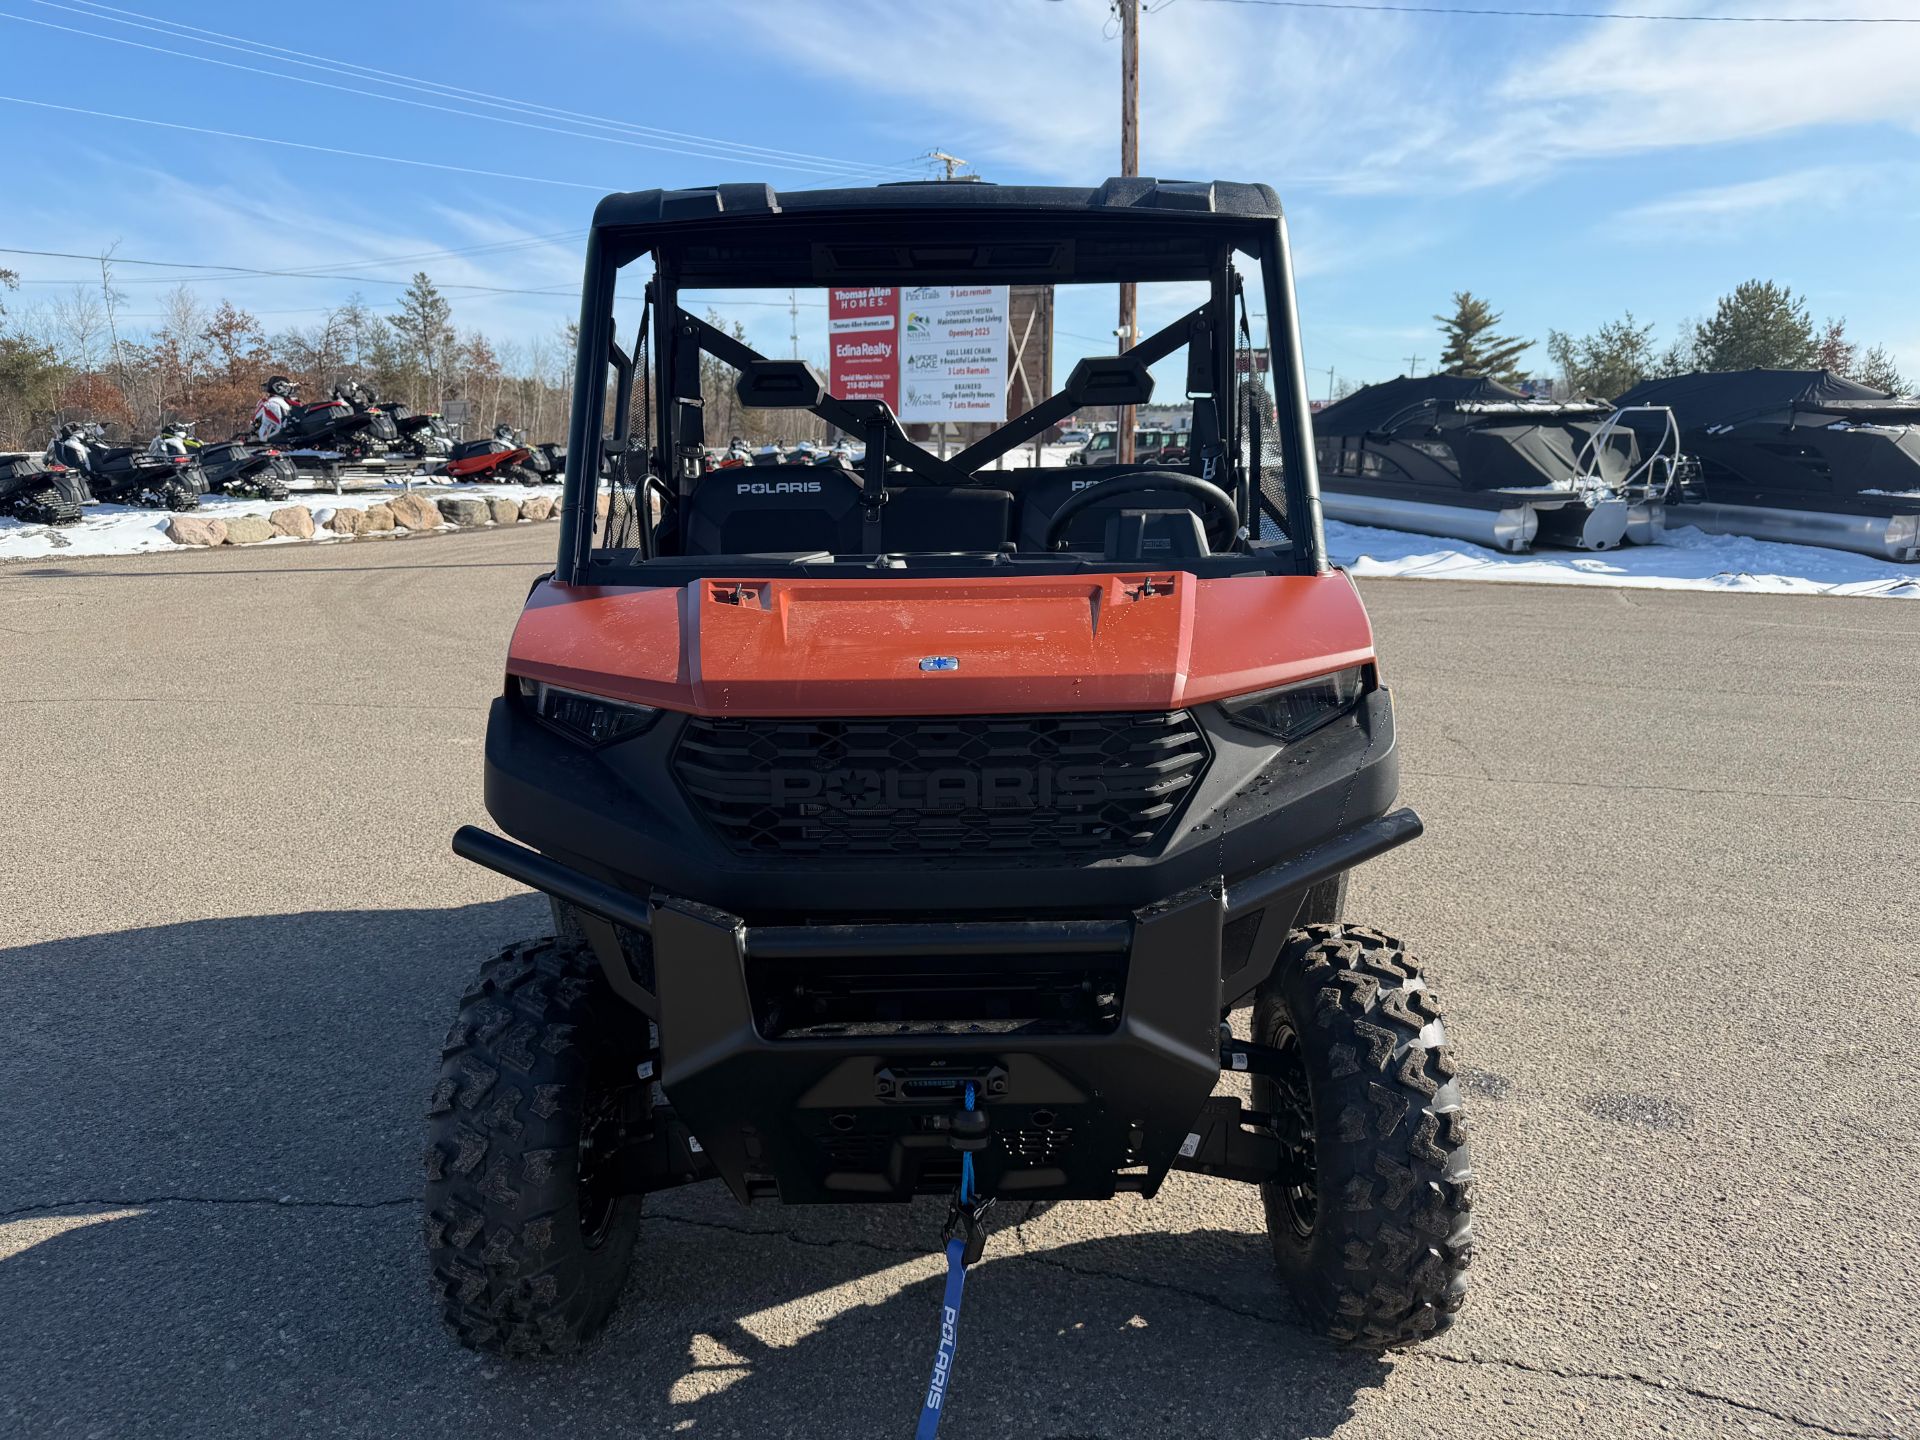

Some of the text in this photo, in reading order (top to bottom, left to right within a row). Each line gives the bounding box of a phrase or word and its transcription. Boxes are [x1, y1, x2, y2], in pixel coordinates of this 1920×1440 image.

[835, 287, 891, 301] Thomas Allen
[921, 289, 940, 300] Trails
[956, 289, 968, 297] Lots
[969, 287, 992, 296] remain
[945, 308, 973, 317] DOWNTOWN
[937, 316, 971, 325] Maintenance
[985, 314, 1003, 323] Living
[949, 327, 991, 338] Opening 2025
[946, 347, 992, 356] GULL LAKE CHAIN
[915, 360, 938, 368] LAKE
[944, 357, 967, 365] Beautiful
[967, 356, 979, 364] Lake
[953, 367, 966, 375] Lots
[966, 366, 990, 375] Remain
[942, 390, 996, 400] Single Family Homes
[949, 400, 991, 409] 7 Lots Remain
[736, 481, 822, 495] POLARIS
[771, 766, 1109, 810] POLARIS
[926, 1305, 957, 1410] POLARIS
